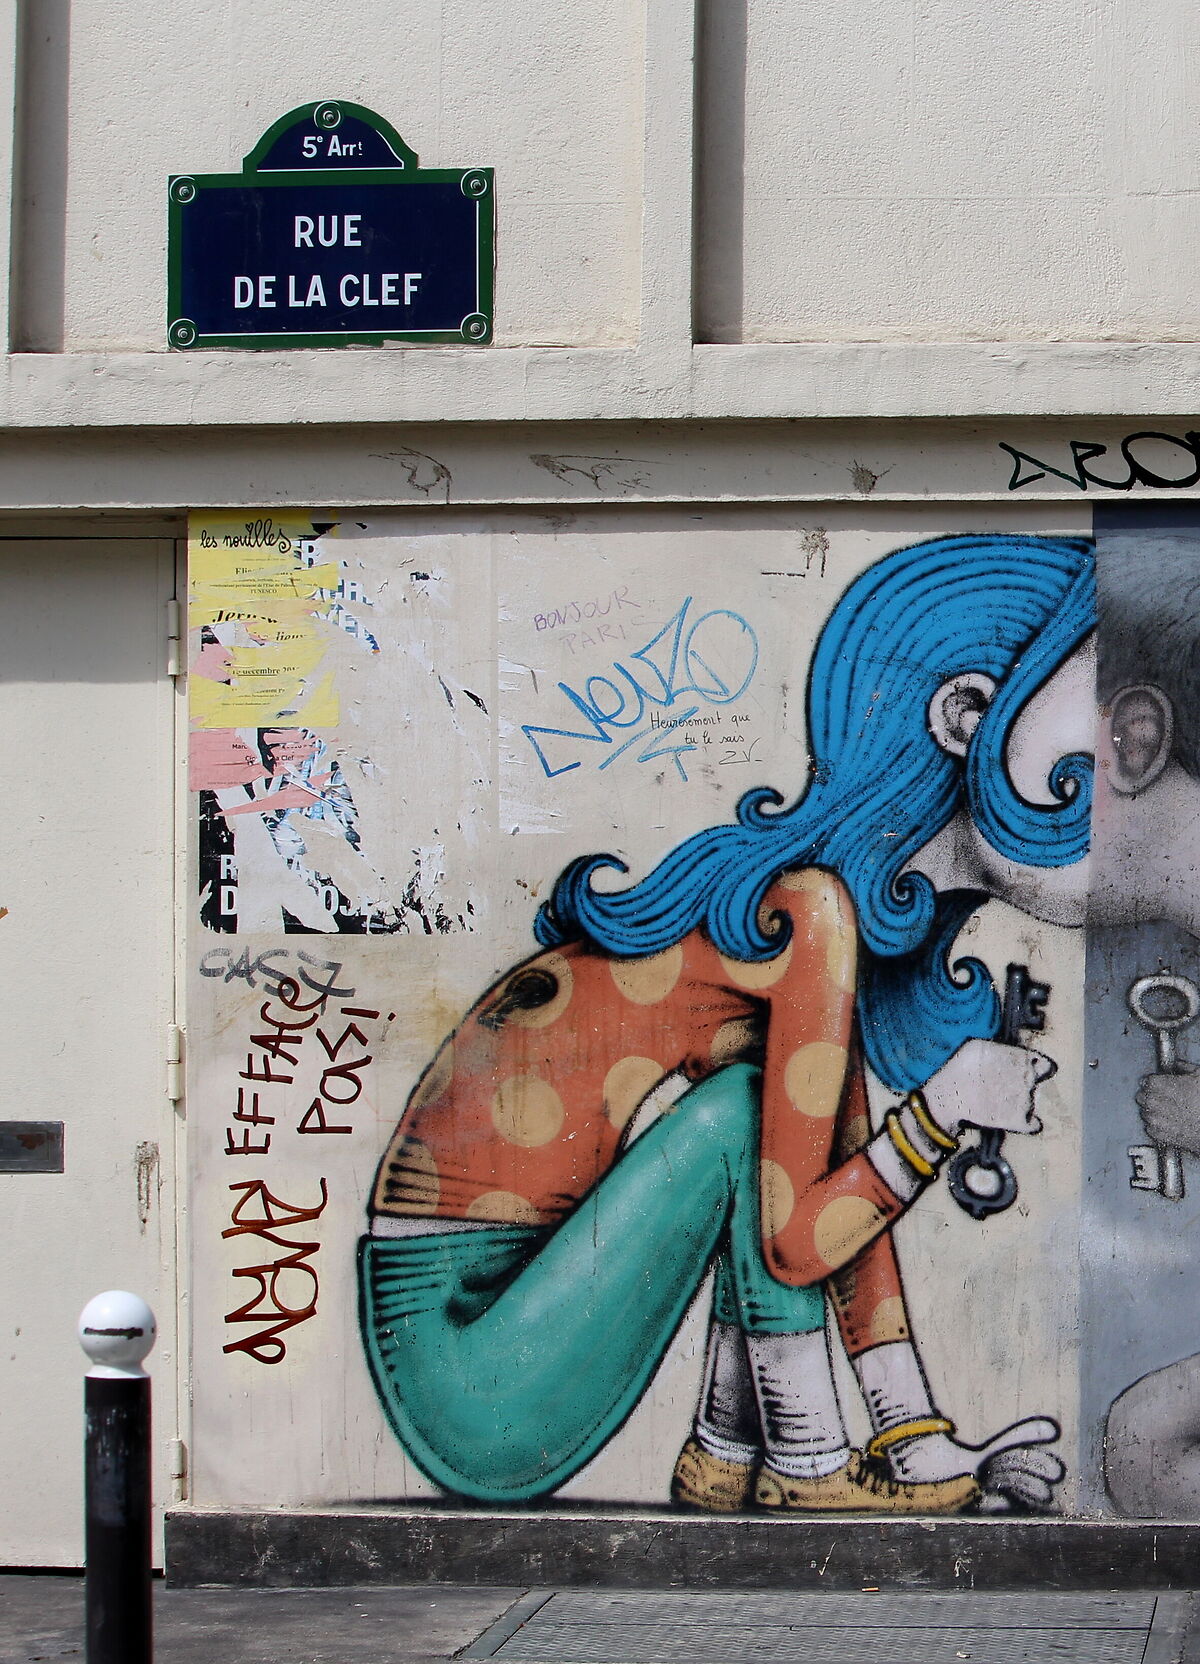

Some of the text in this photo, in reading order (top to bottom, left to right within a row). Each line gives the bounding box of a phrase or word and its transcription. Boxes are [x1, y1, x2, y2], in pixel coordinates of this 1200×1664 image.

[294, 214, 362, 248] RUE
[234, 273, 422, 309] DE LA CLEF
[200, 529, 218, 549] les
[222, 518, 293, 554] nouilles
[534, 585, 641, 632] BONJOUR
[684, 730, 745, 744] tu le sais
[731, 714, 751, 727] que
